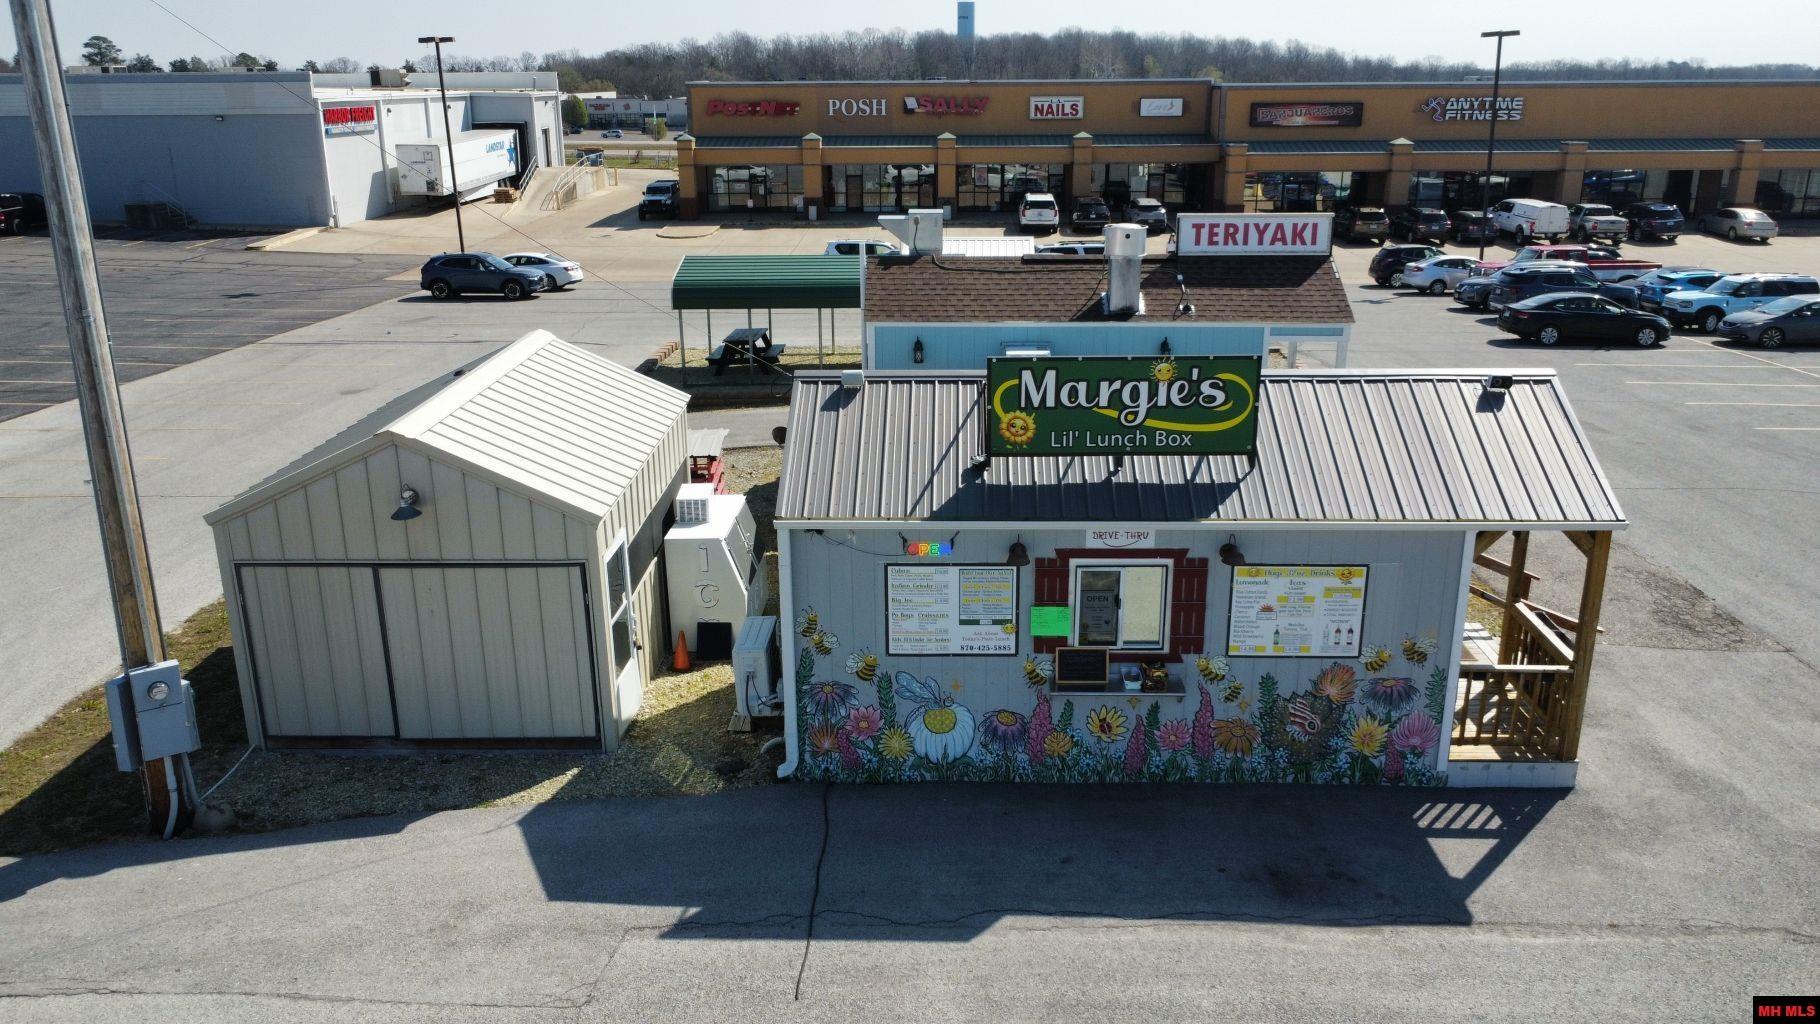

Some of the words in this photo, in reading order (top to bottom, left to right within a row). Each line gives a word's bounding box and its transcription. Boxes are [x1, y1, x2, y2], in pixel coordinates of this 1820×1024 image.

[828, 98, 887, 116] POSH
[918, 96, 989, 113] SALLY
[1033, 103, 1080, 117] NAILS
[1445, 97, 1523, 109] ANYTME
[1192, 222, 1319, 247] TERIYAKI
[1020, 368, 1226, 427] Margie's
[1051, 431, 1079, 448] Lil'
[1086, 431, 1147, 447] Lunch
[1155, 431, 1192, 446] Box
